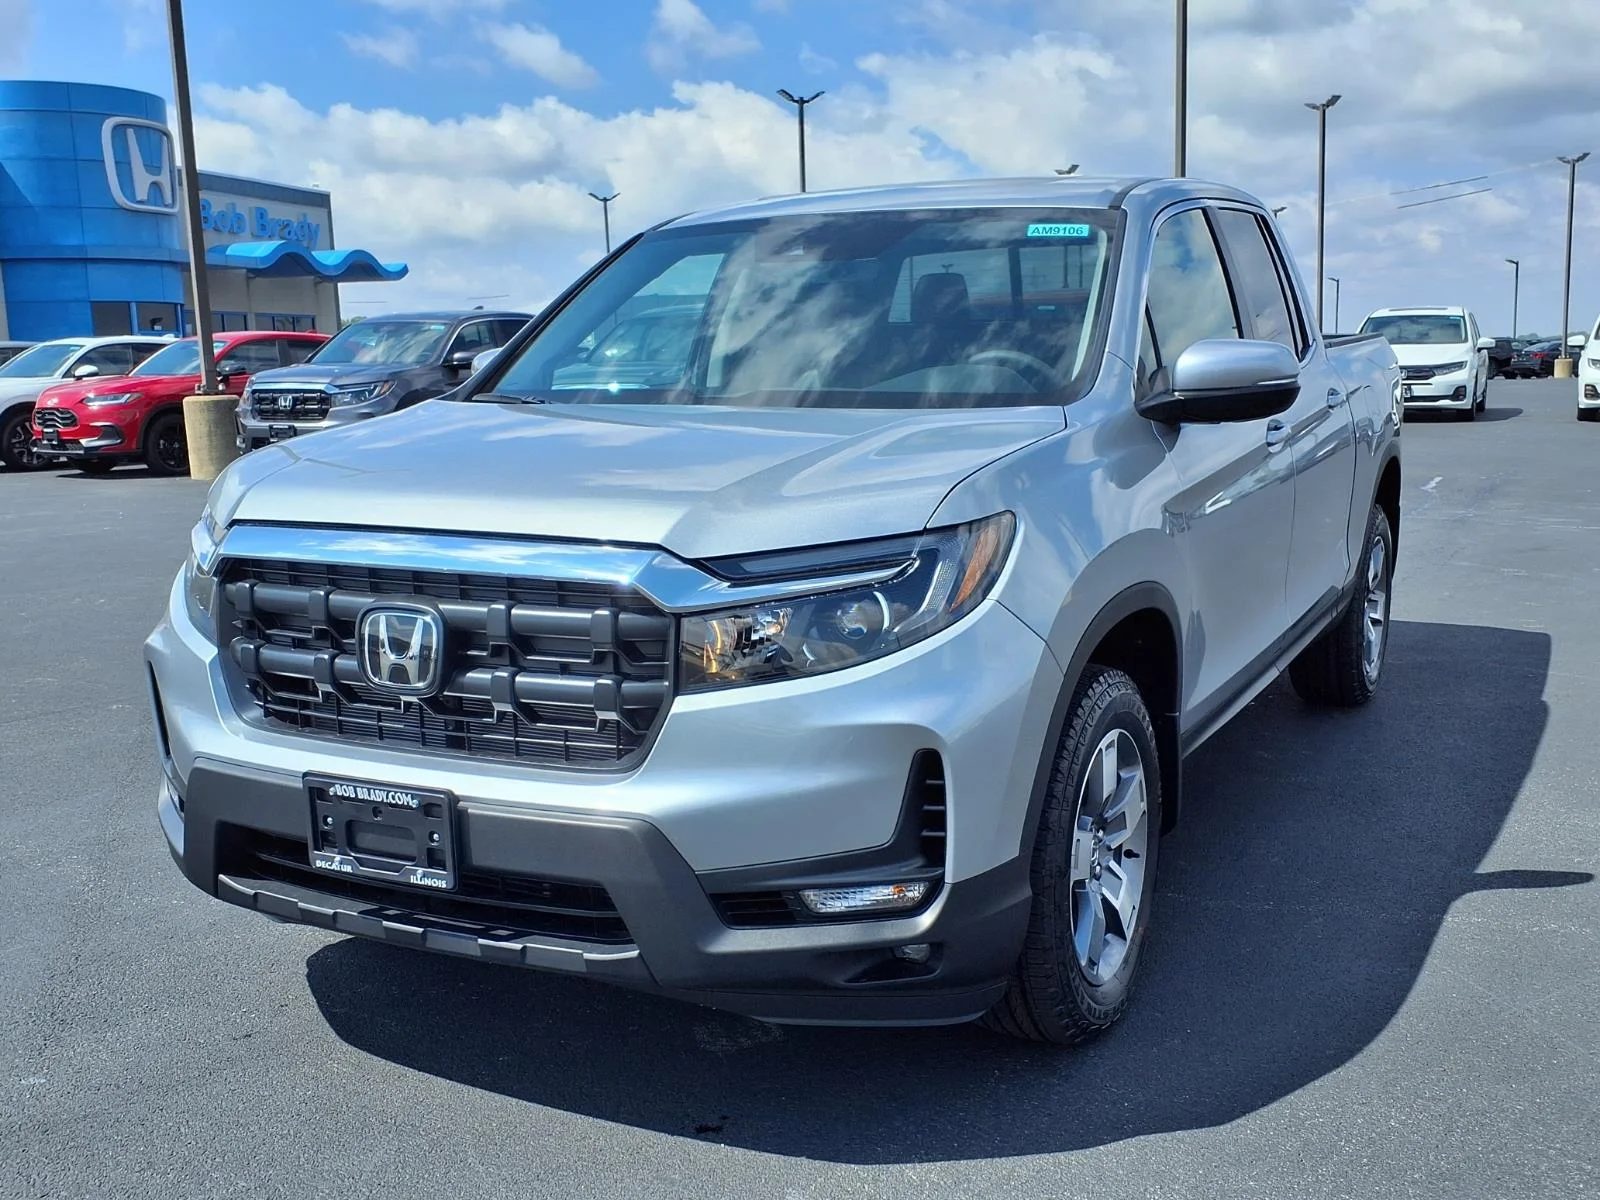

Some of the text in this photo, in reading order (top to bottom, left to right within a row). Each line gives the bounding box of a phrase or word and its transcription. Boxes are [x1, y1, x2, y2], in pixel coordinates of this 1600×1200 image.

[200, 198, 321, 249] Bob Brady
[1031, 226, 1084, 235] AM9106
[334, 784, 413, 806] BOB BRADY.COM
